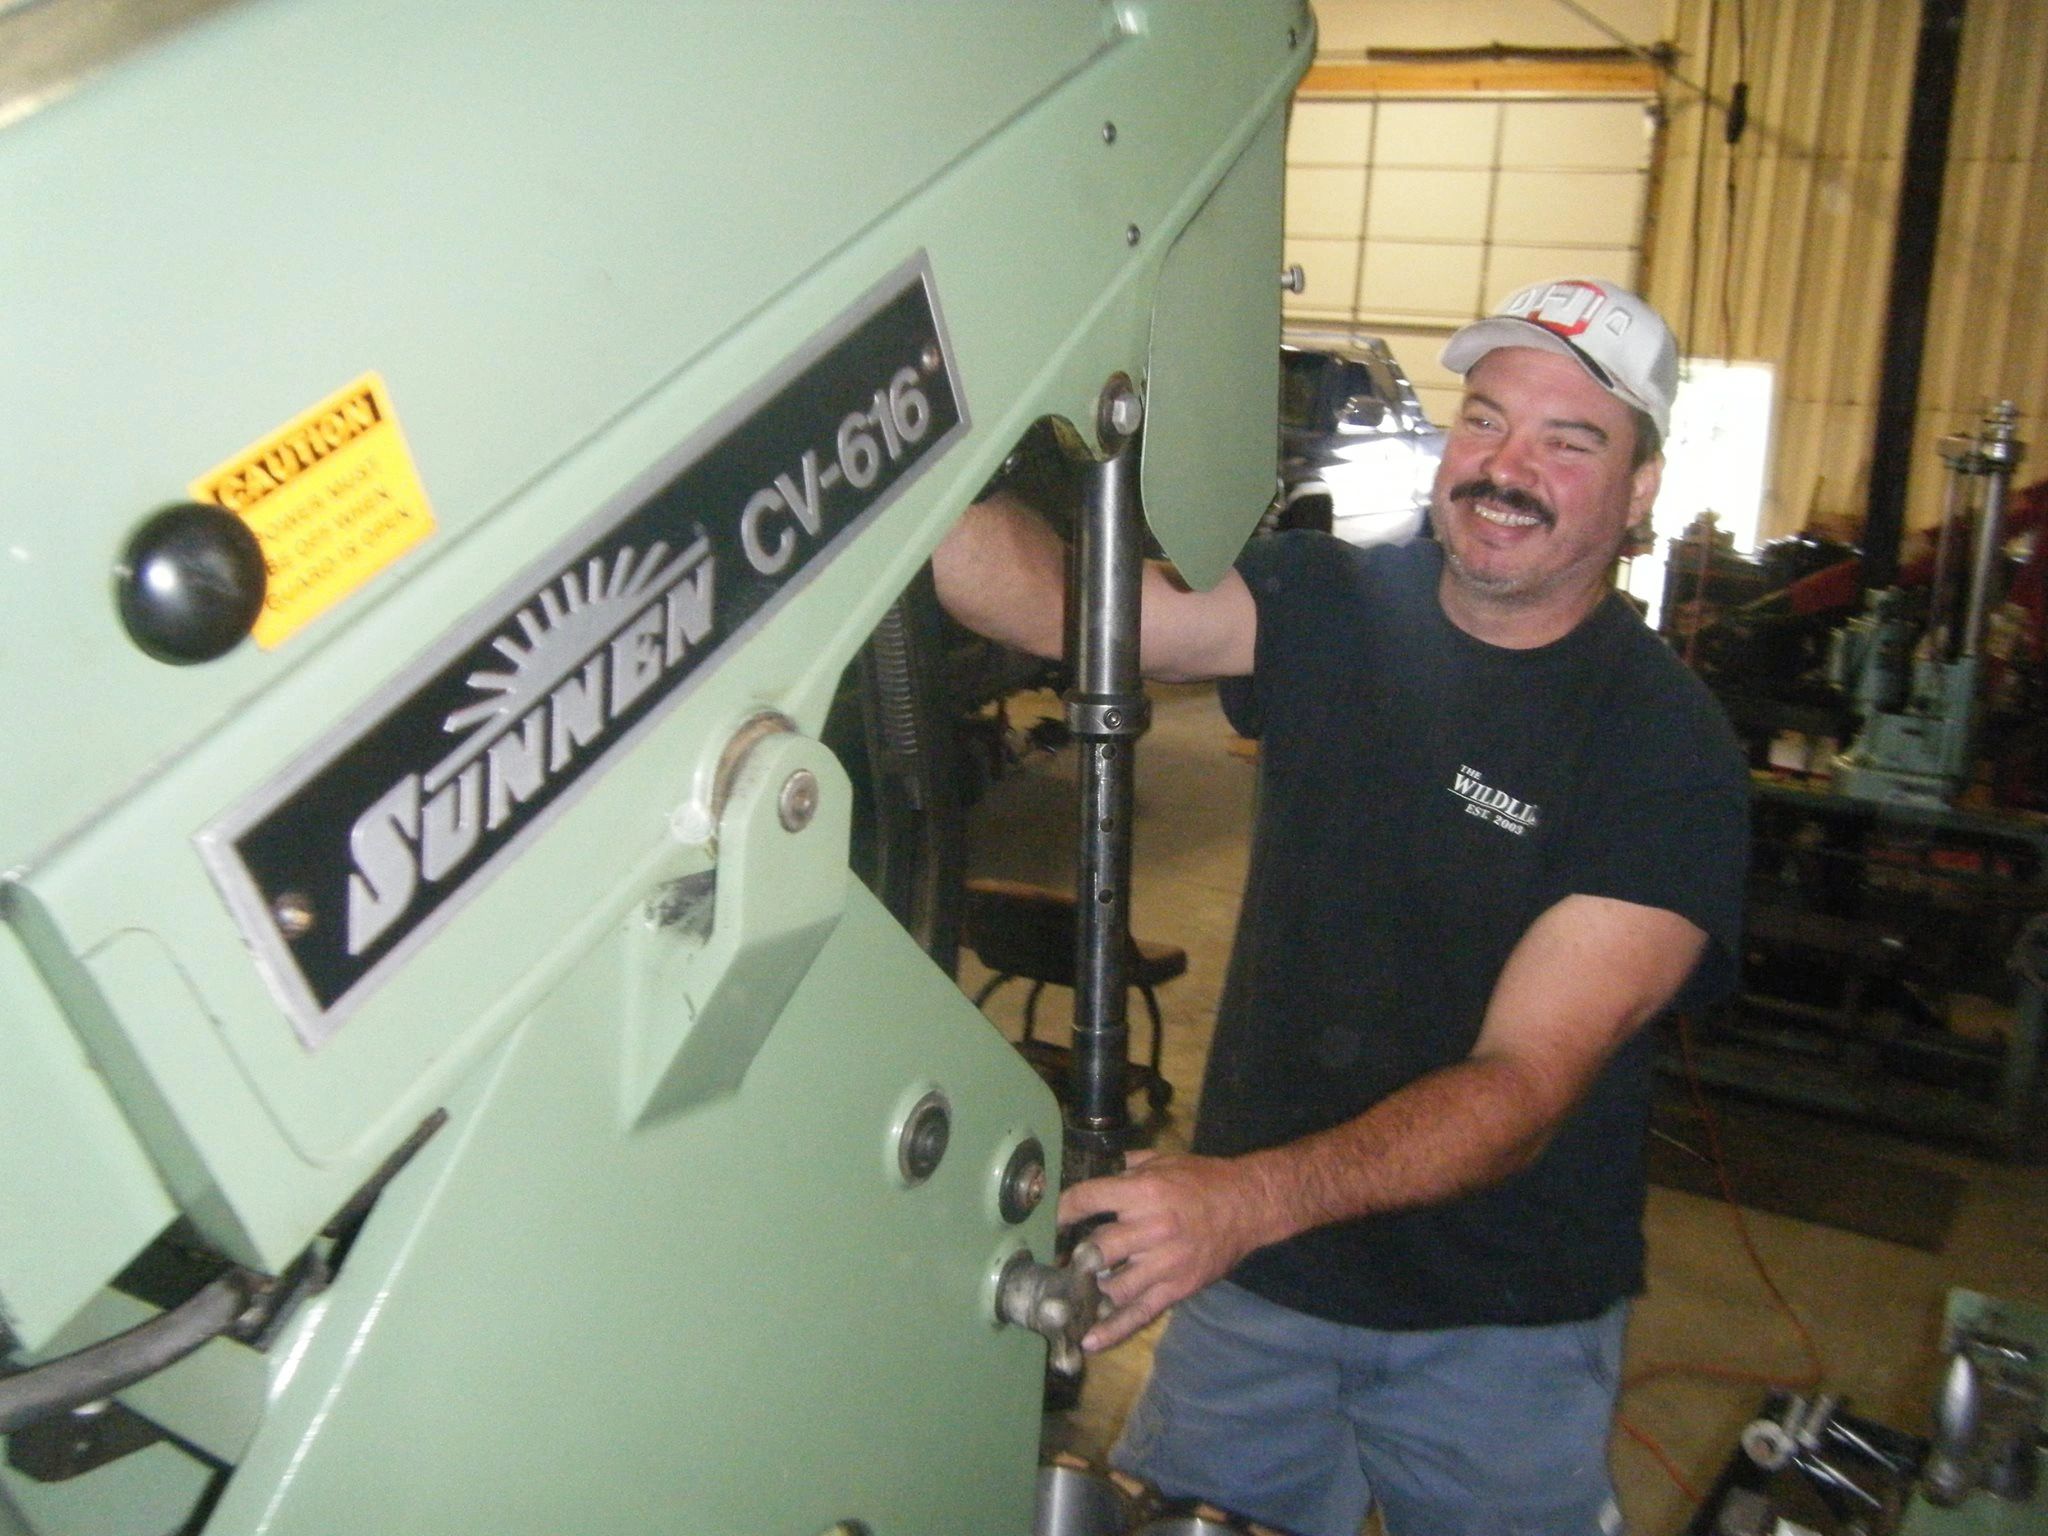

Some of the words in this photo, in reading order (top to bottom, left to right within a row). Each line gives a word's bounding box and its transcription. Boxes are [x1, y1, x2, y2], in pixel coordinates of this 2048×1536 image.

[211, 390, 382, 507] CAUTION
[741, 366, 930, 575] CV-616
[347, 555, 717, 956] SUNNEN
[1460, 764, 1482, 780] THE
